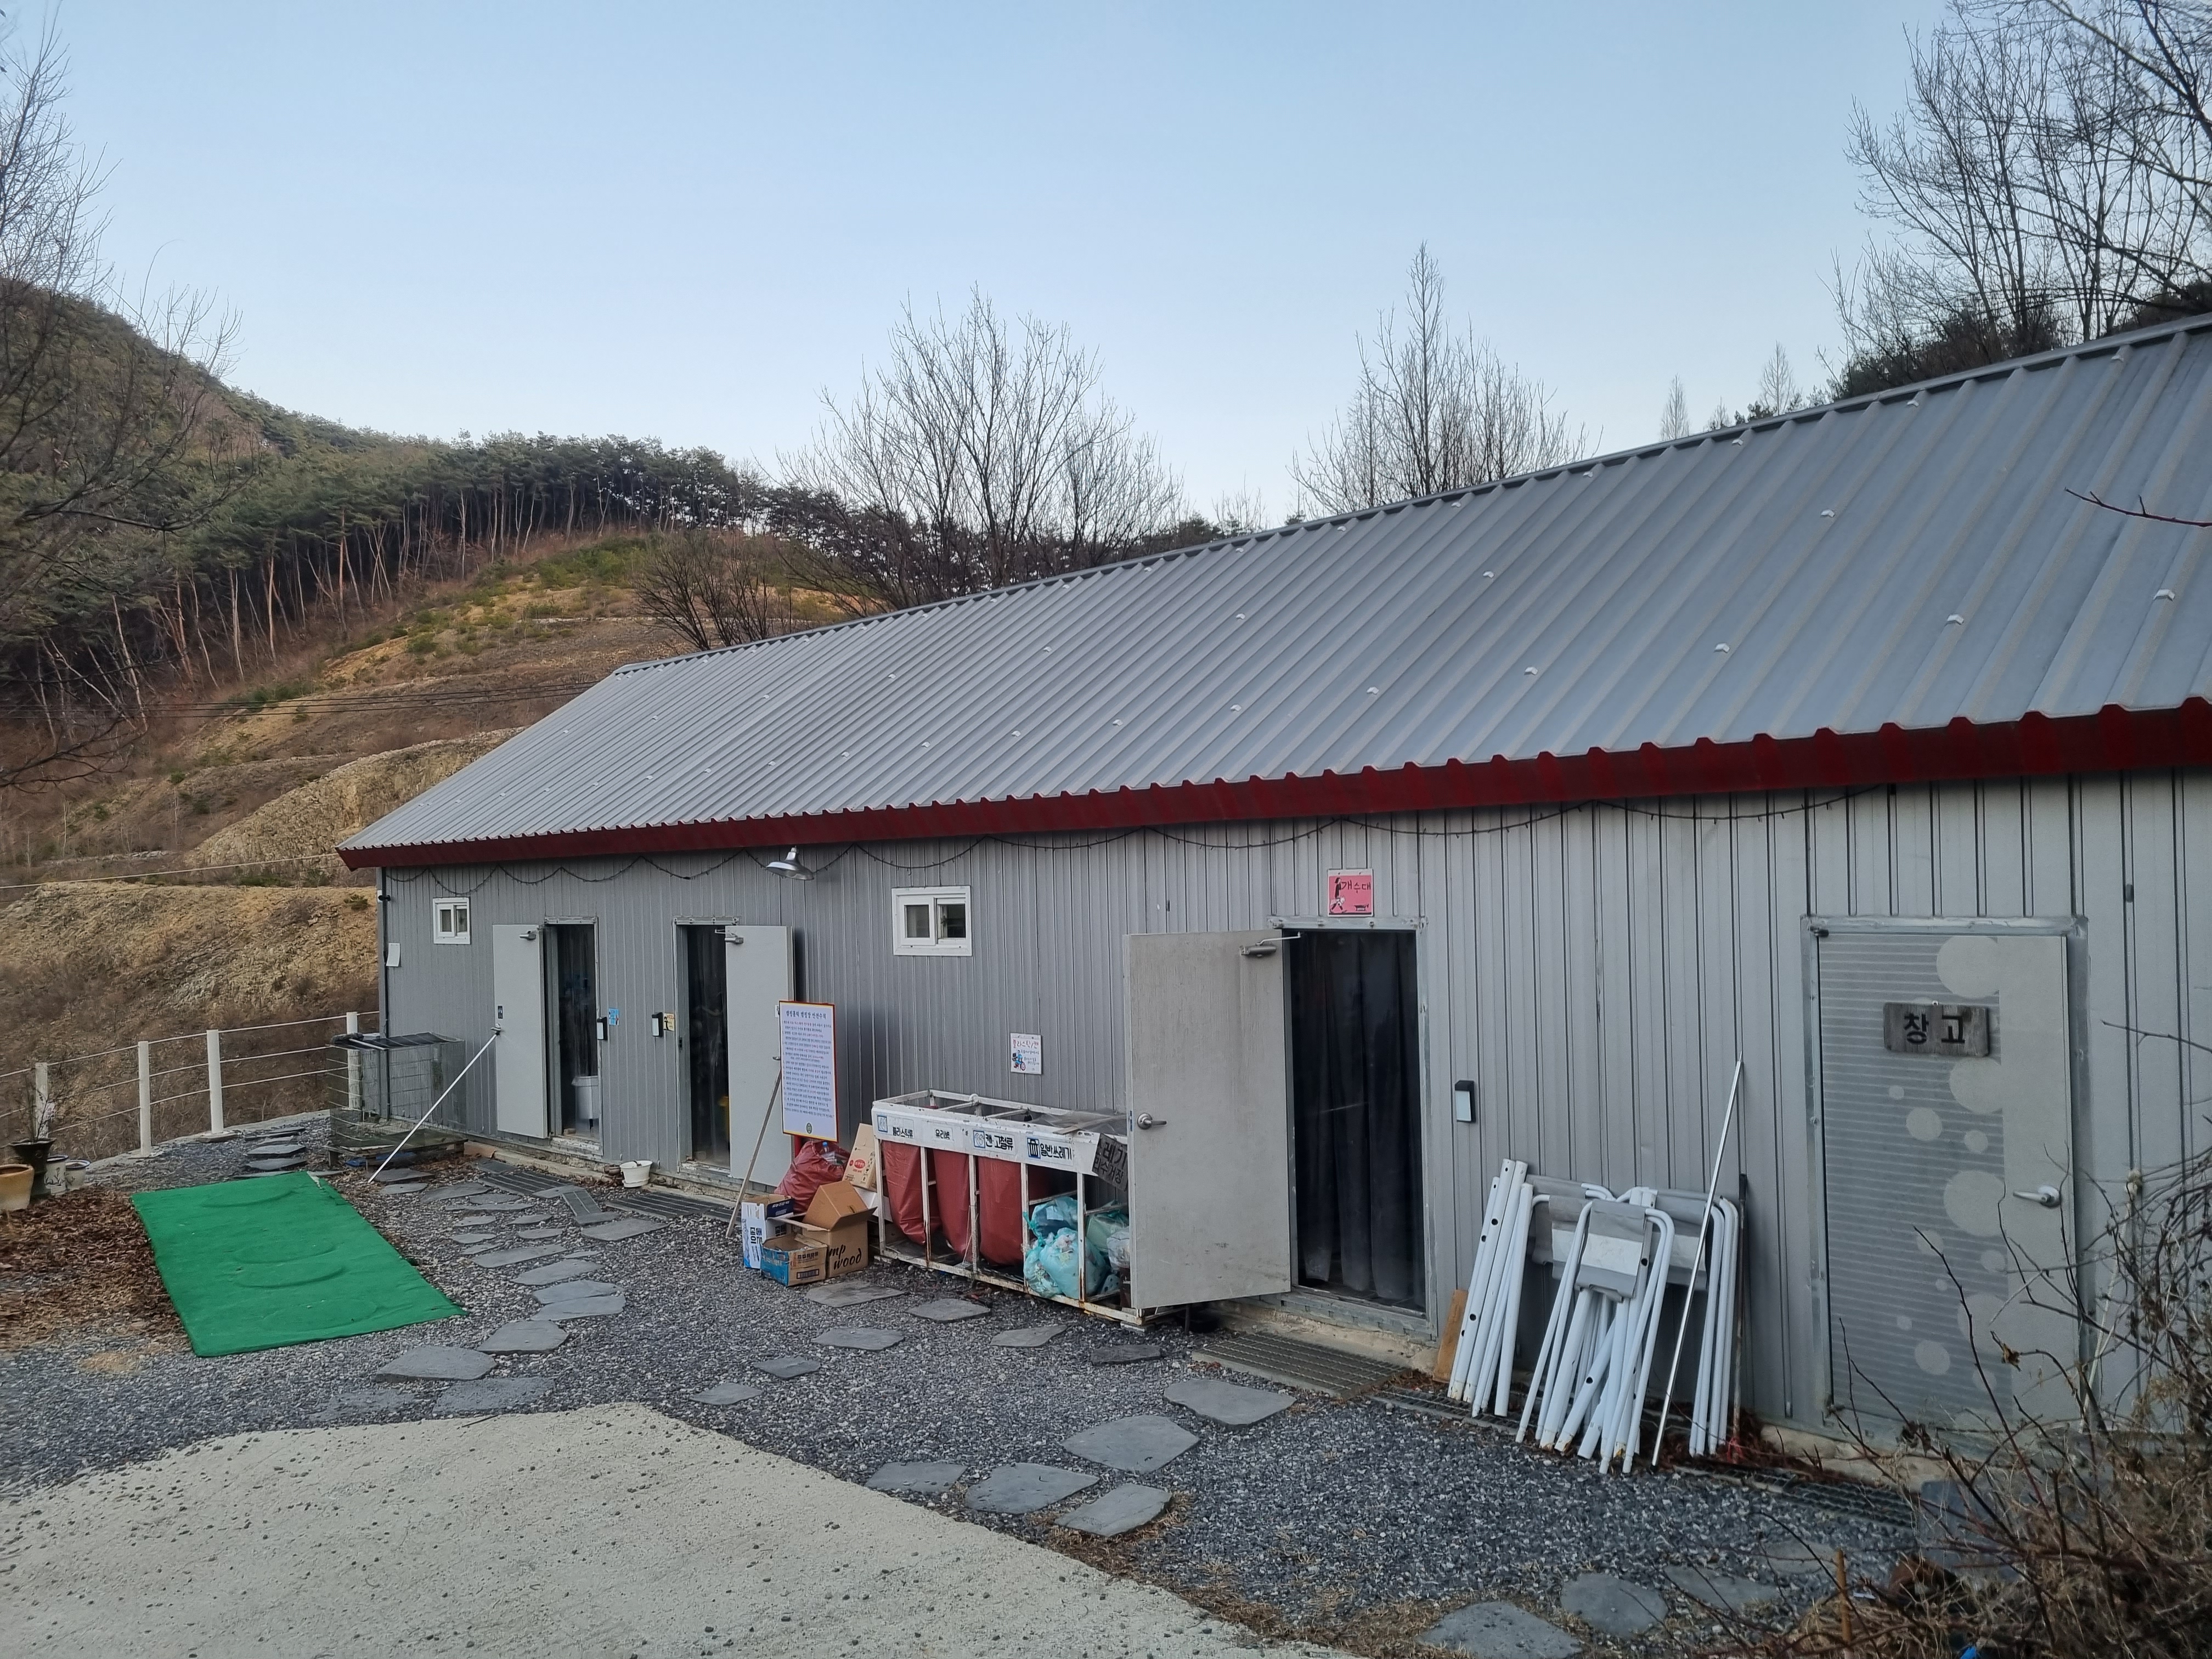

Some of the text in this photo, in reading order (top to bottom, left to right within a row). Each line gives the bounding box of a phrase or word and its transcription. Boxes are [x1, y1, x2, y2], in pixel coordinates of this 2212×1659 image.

[1341, 880, 1371, 893] 개수대
[1904, 1013, 1966, 1045] 창고
[893, 1126, 913, 1139] 플라스틱류
[935, 1129, 950, 1140] 유리병
[1040, 1143, 1072, 1160] 일반쓰레기
[833, 1248, 862, 1270] wood
